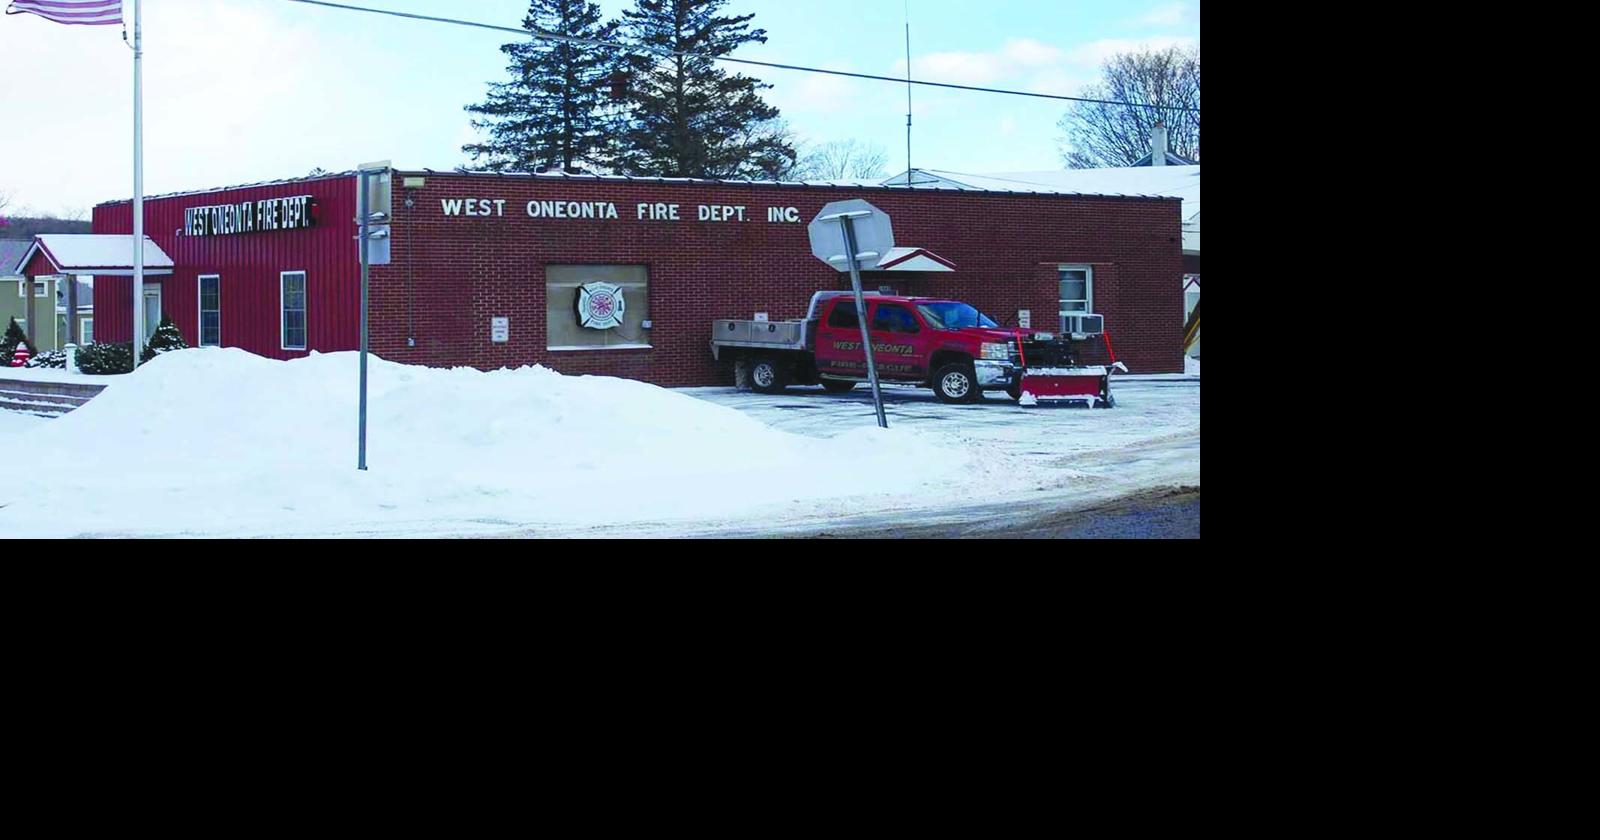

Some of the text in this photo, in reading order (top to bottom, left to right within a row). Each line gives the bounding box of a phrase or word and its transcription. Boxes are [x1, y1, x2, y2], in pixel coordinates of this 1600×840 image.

[185, 197, 309, 236] WEST ONEONTA FIRE DEPT.
[441, 199, 801, 223] WEST ONEONTA FIRE DEPT. INC.
[833, 341, 861, 351] WEST
